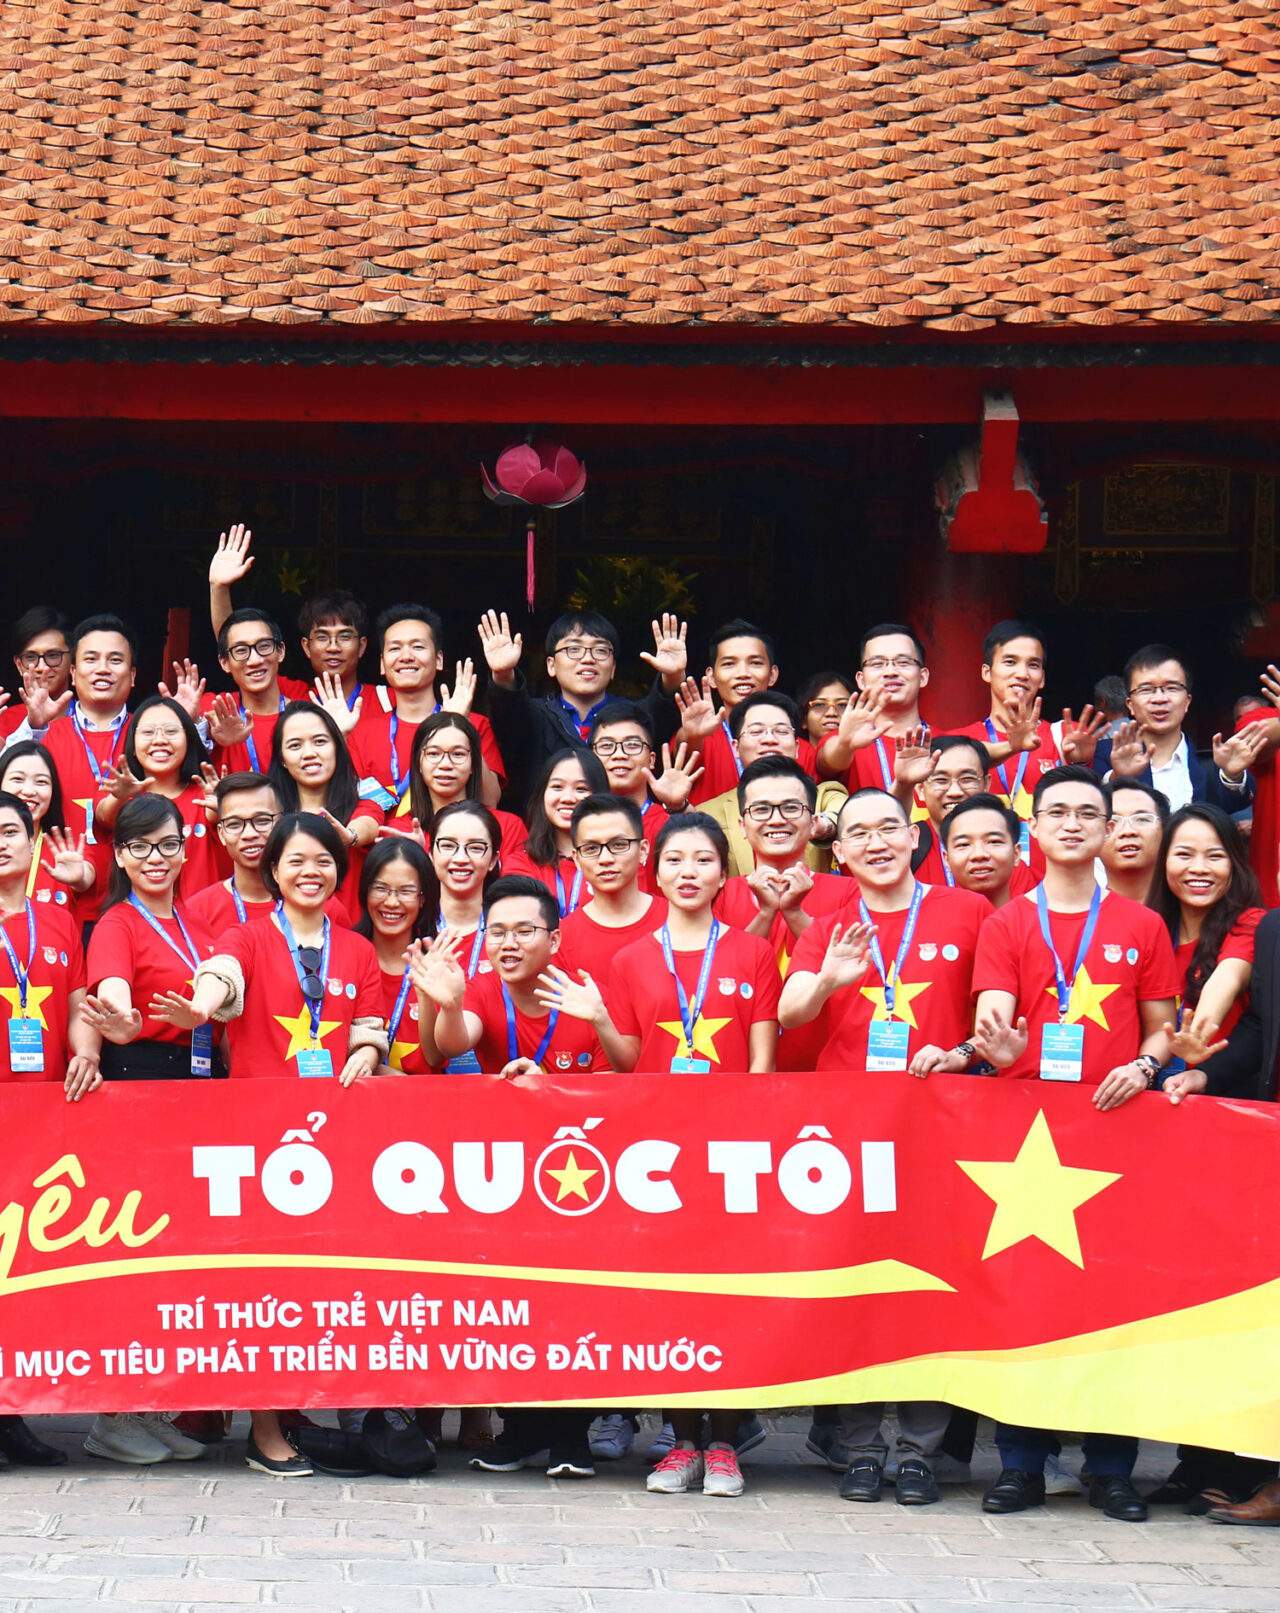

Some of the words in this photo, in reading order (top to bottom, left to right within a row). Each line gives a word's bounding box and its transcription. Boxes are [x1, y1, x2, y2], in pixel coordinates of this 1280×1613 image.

[192, 1111, 334, 1217] TỔ
[372, 1117, 682, 1217] QUỐC
[707, 1124, 897, 1215] TÔI
[157, 1295, 206, 1330] TRÍ
[214, 1294, 304, 1329] THỨC
[312, 1291, 366, 1327] TRẺ
[376, 1292, 444, 1334] VIỆT
[453, 1300, 530, 1327] NAM
[15, 1350, 92, 1385] MỤC
[100, 1341, 166, 1376] TIÊU
[176, 1338, 261, 1374] PHÁT
[268, 1330, 358, 1373] TRIỂN
[368, 1331, 429, 1371] BỀN
[438, 1337, 538, 1372] VỮNG
[545, 1331, 613, 1372] ĐẤT
[622, 1336, 724, 1373] NƯỚC
